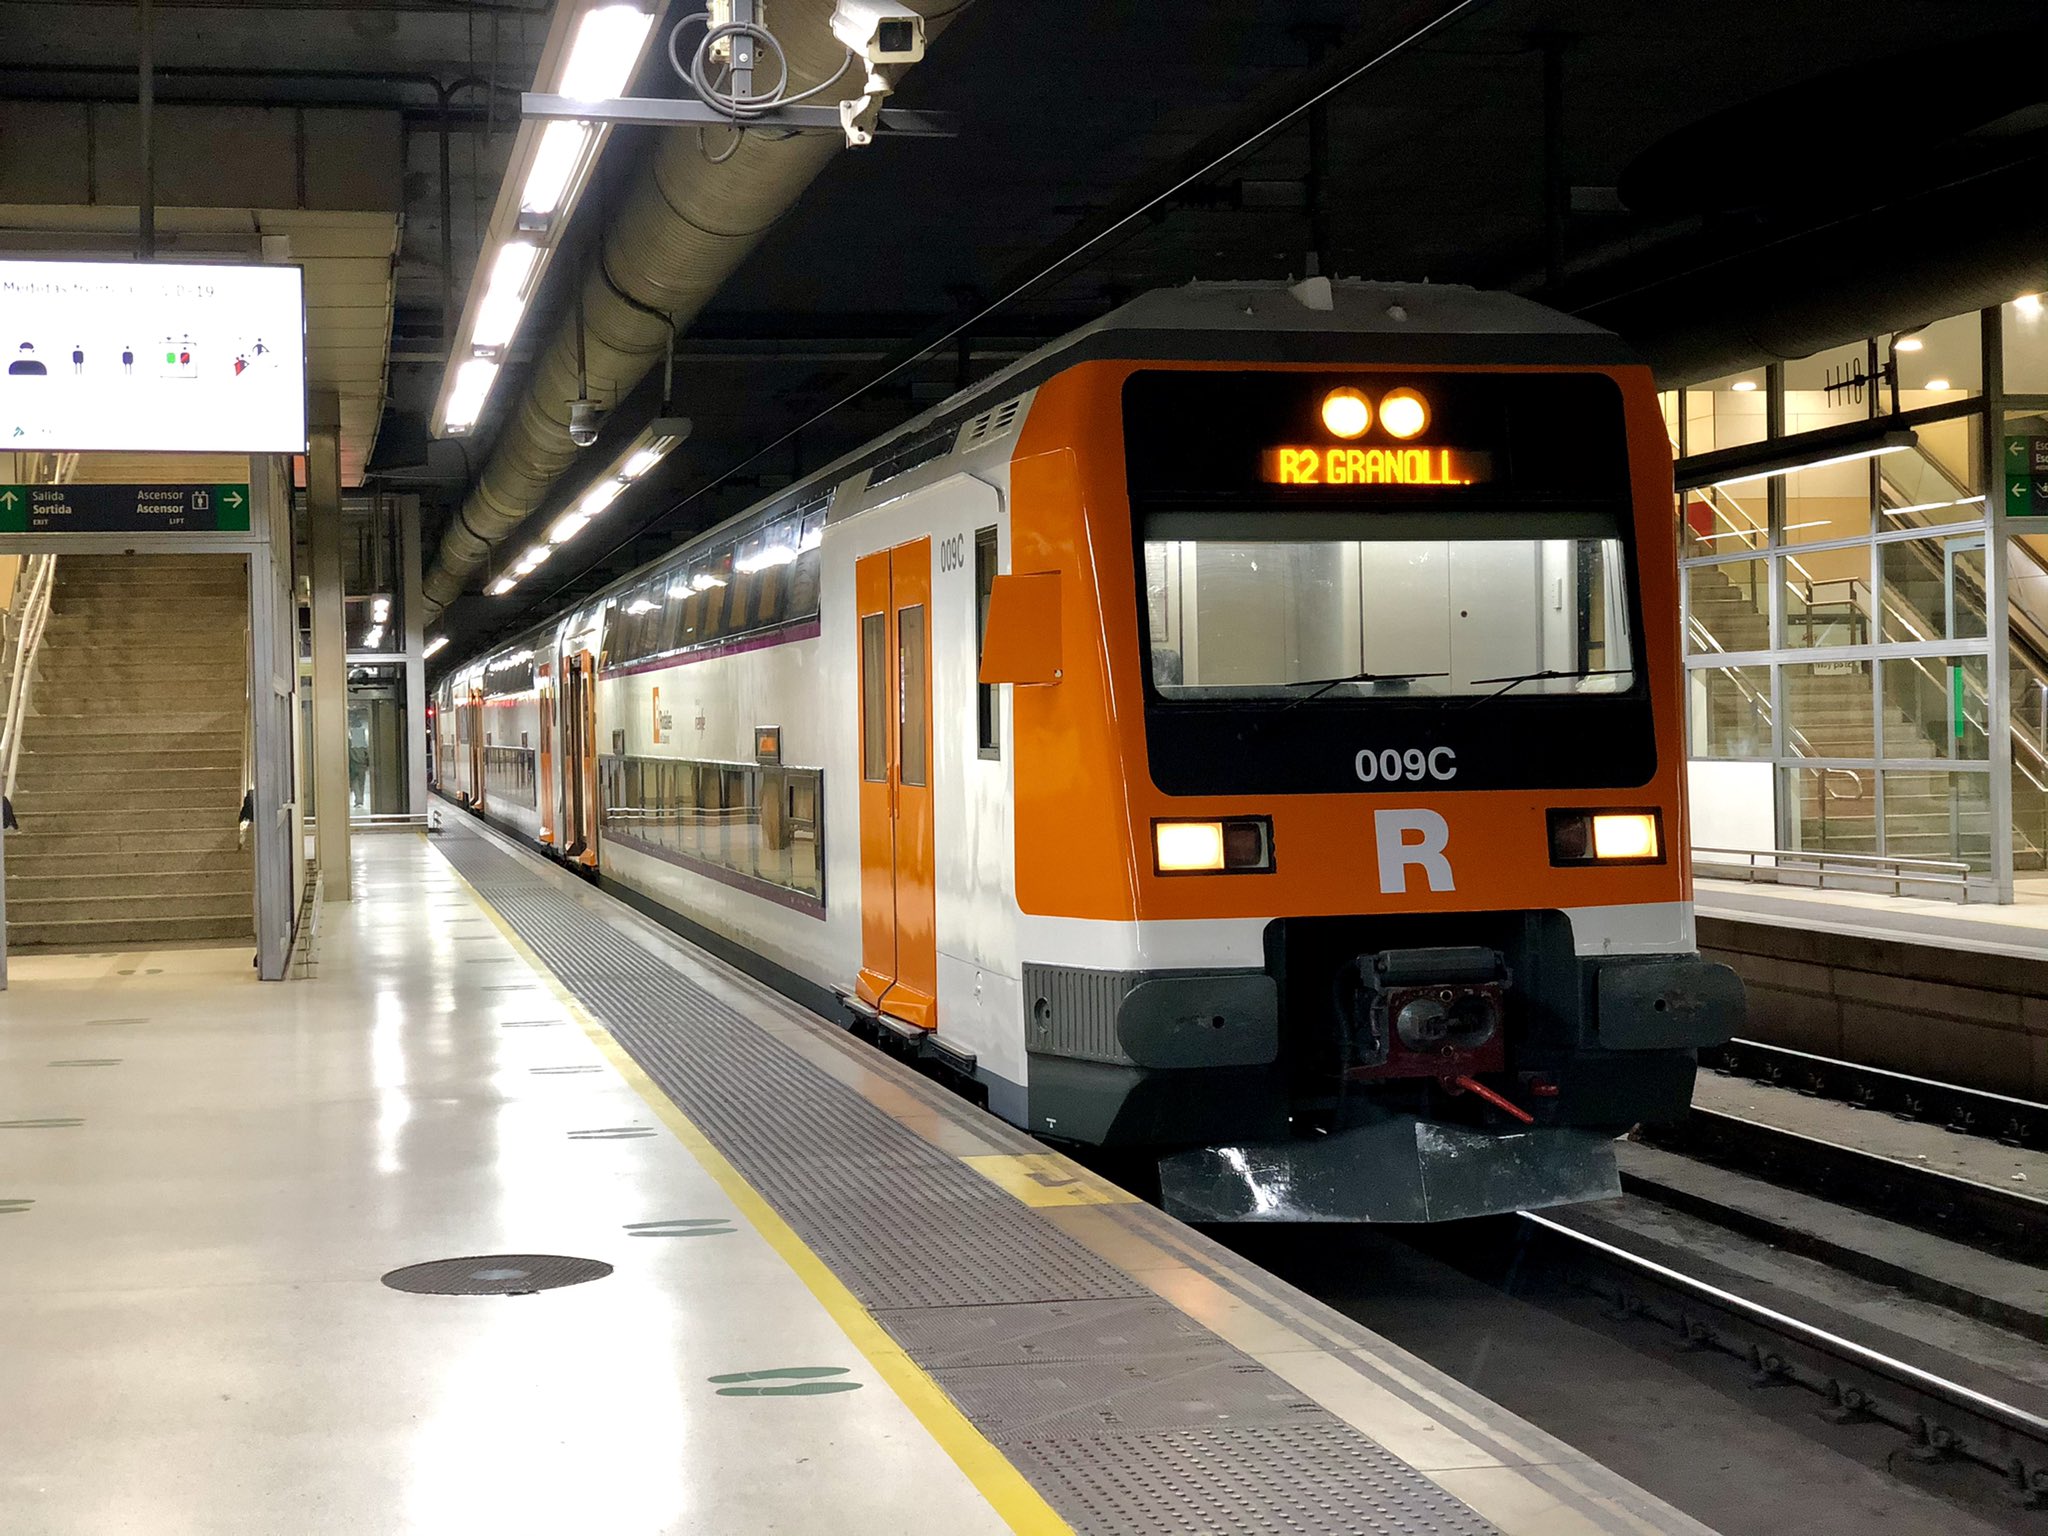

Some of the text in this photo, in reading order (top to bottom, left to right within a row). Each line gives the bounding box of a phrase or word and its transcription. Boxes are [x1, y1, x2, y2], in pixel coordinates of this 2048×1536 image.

[1279, 447, 1320, 484] R2
[32, 490, 65, 501] Salida
[137, 490, 184, 500] Ascensor
[33, 504, 72, 515] Sortida
[136, 504, 184, 514] Ascensor
[941, 533, 964, 572] 009C
[1355, 746, 1457, 782] 009C
[1373, 808, 1456, 895] R
